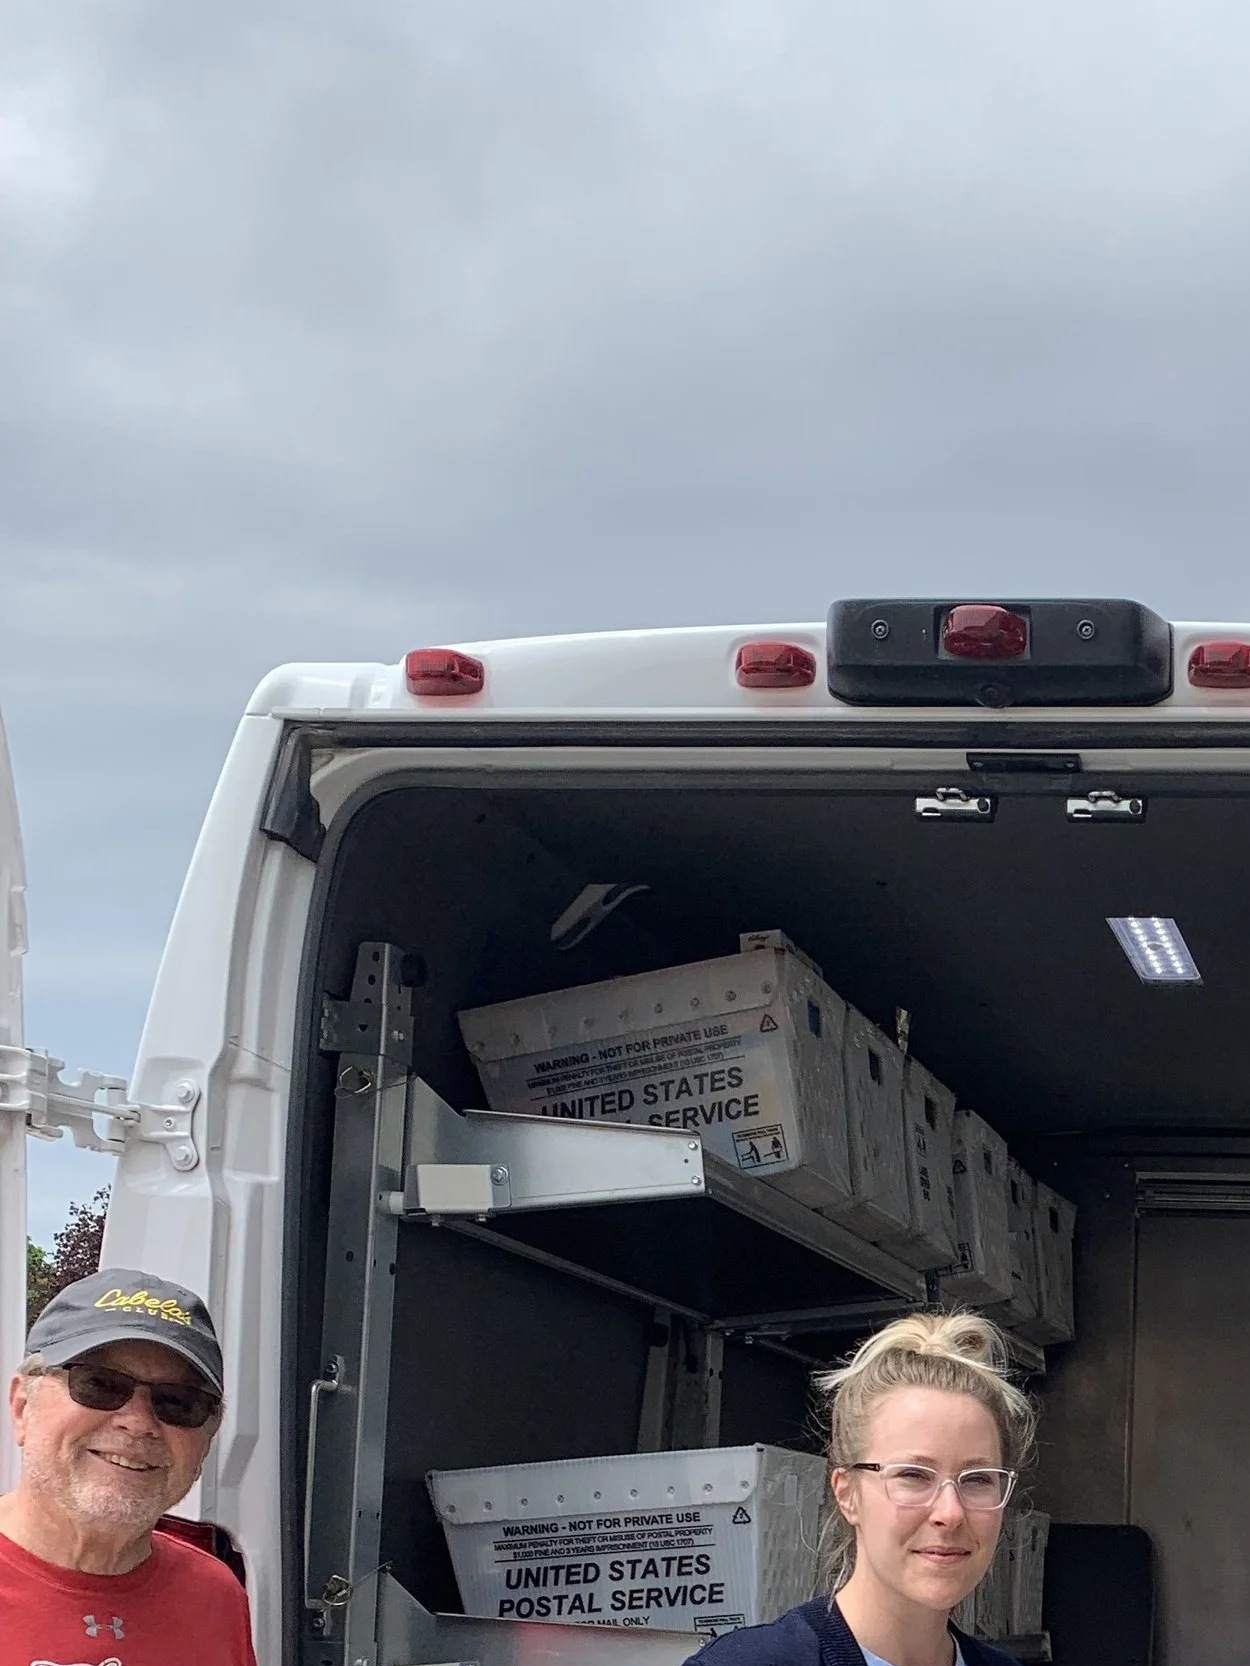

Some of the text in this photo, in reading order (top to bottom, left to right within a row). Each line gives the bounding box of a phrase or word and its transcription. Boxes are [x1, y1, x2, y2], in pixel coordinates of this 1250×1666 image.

[534, 1025, 728, 1074] WARNING NOT FOR PRIVATE USE
[643, 1066, 743, 1105] STATES
[95, 1288, 192, 1325] Cabela's
[502, 1512, 700, 1537] WARNING NOT FOR PRIVATE USE
[505, 1554, 711, 1590] UNITED STATES
[499, 1583, 725, 1619] POSTAL SERVICE
[623, 1616, 650, 1626] ONLY
